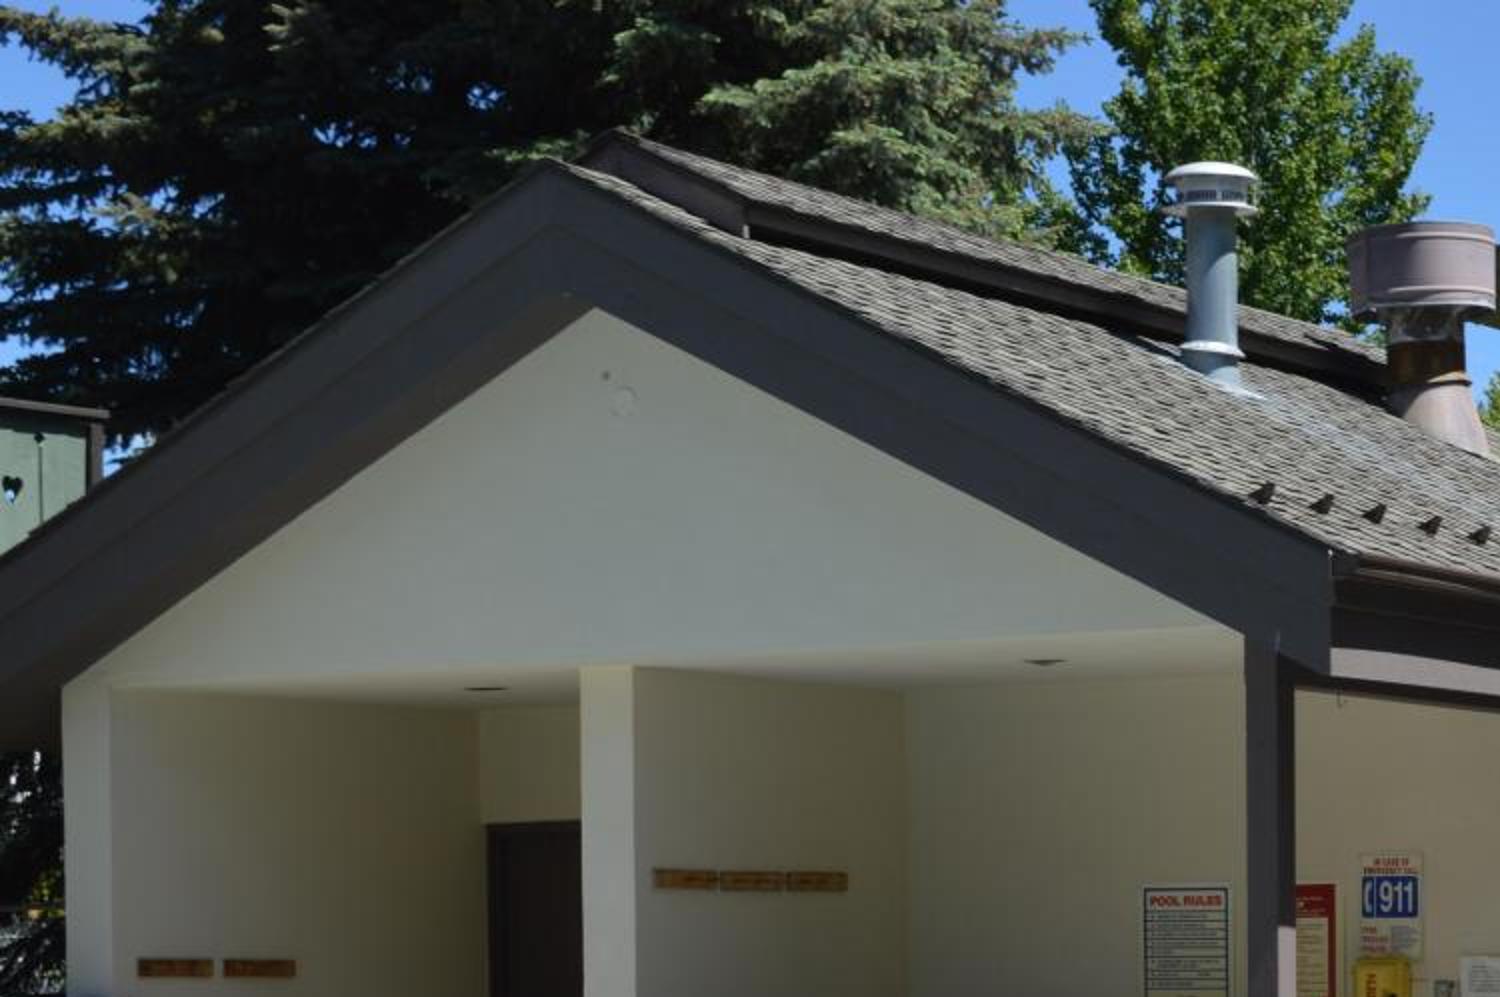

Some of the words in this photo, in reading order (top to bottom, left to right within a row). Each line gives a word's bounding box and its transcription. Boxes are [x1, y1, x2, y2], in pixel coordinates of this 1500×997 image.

[1151, 895, 1181, 907] POOL
[1184, 895, 1222, 907] RULES
[1379, 880, 1414, 913] 911
